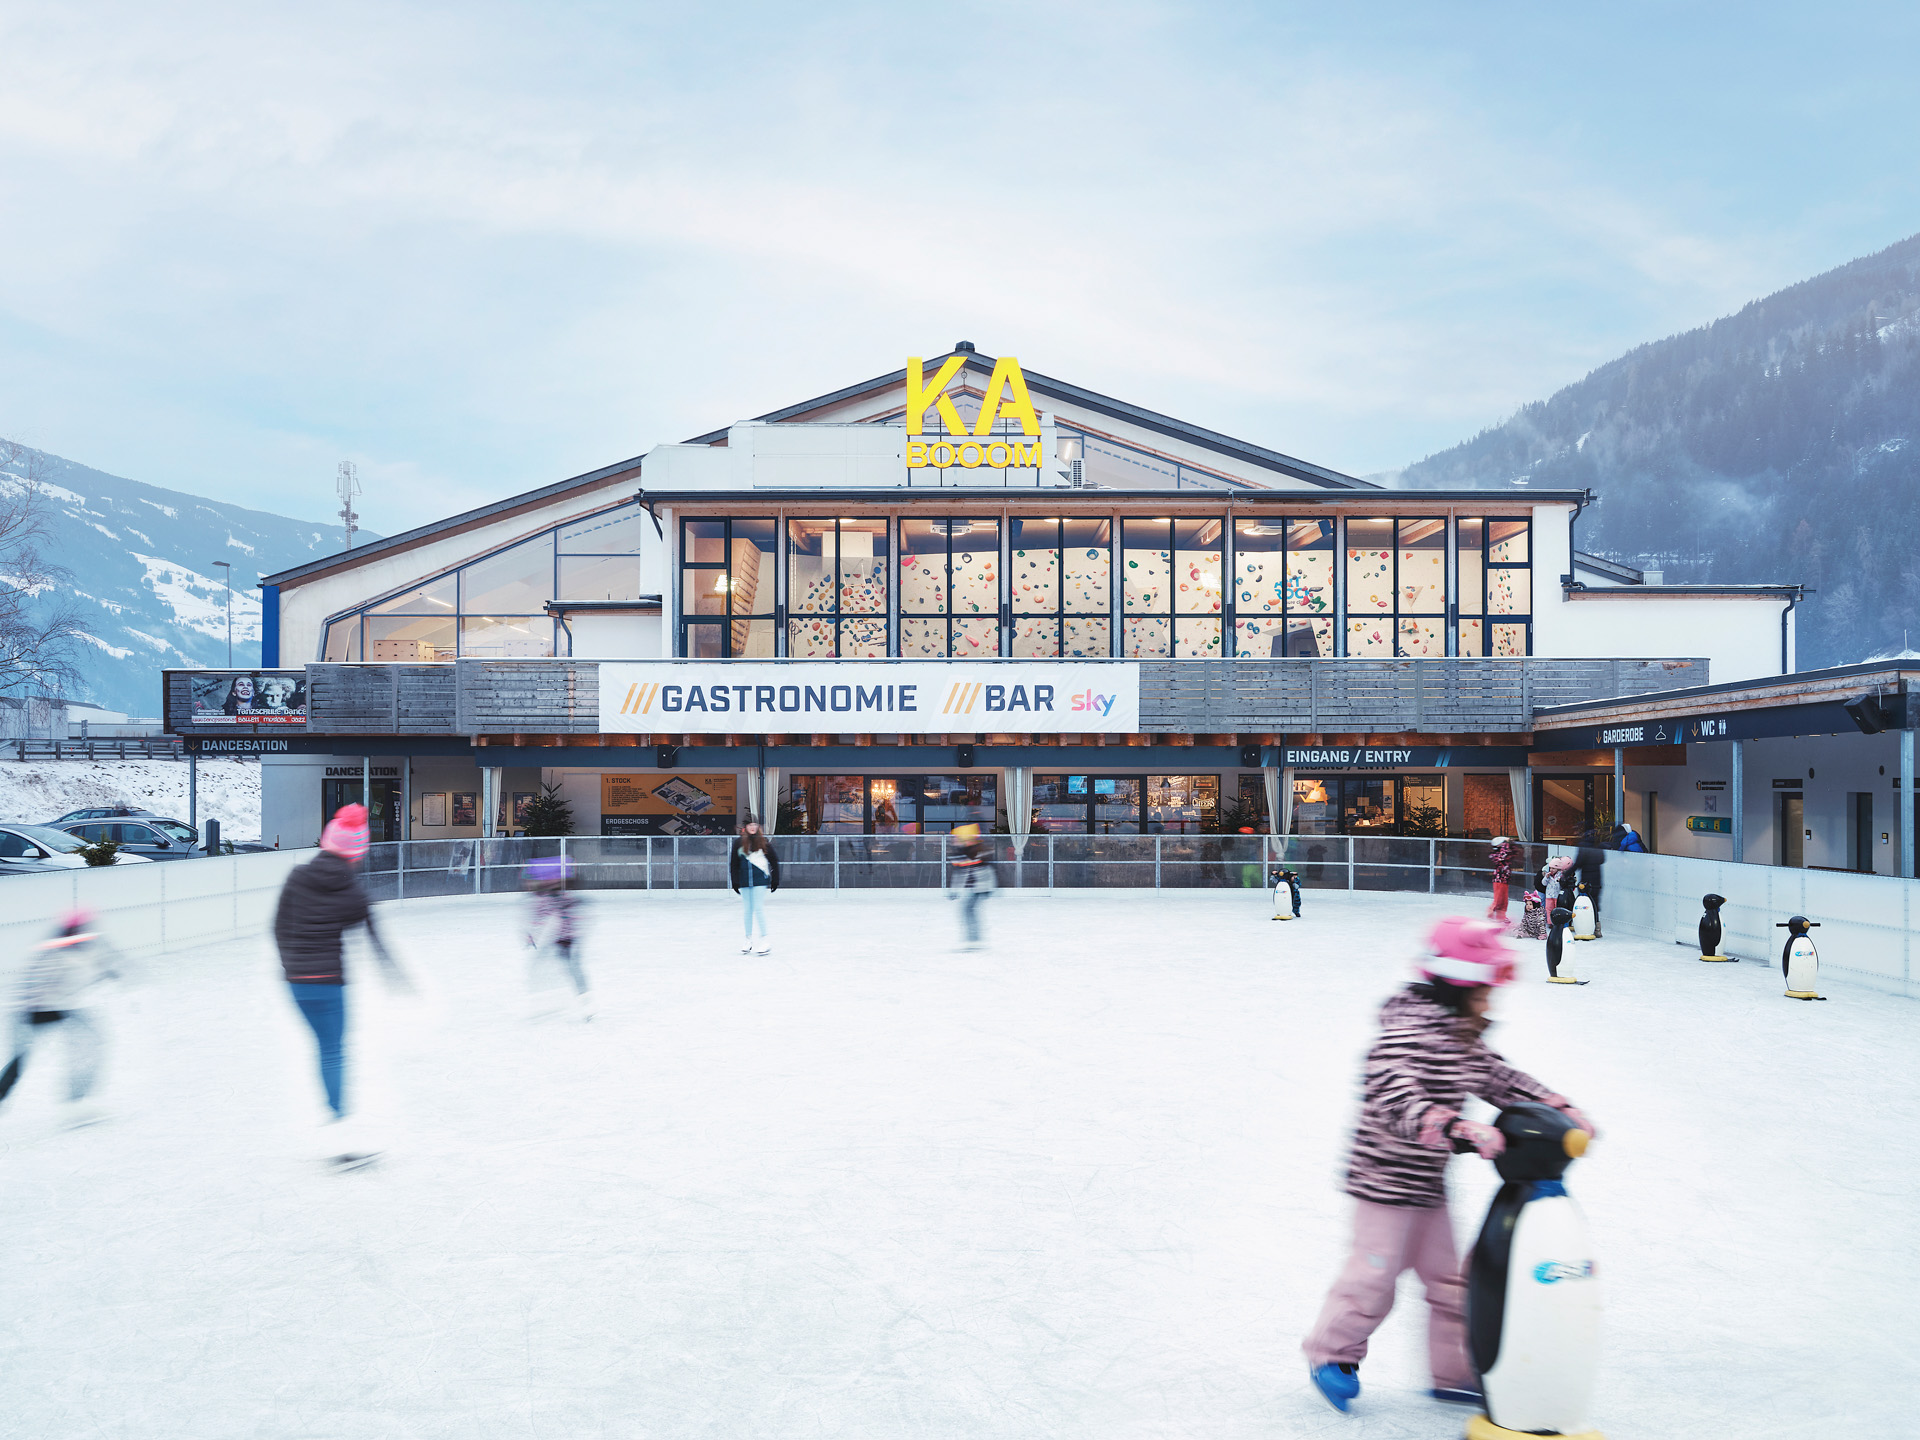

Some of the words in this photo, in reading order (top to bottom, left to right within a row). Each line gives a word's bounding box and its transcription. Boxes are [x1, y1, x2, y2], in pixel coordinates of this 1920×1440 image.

[906, 356, 1042, 436] KA
[906, 441, 1043, 469] BOOOM
[661, 684, 917, 712] GASTRONOMIE
[985, 684, 1055, 712] BAR
[1071, 688, 1117, 717] sky
[1602, 727, 1644, 744] GARDEROBE
[1701, 720, 1715, 736] WC
[202, 740, 288, 751] DANCESATION
[1287, 750, 1350, 763] EINGANG
[1365, 750, 1411, 763] ENTRY
